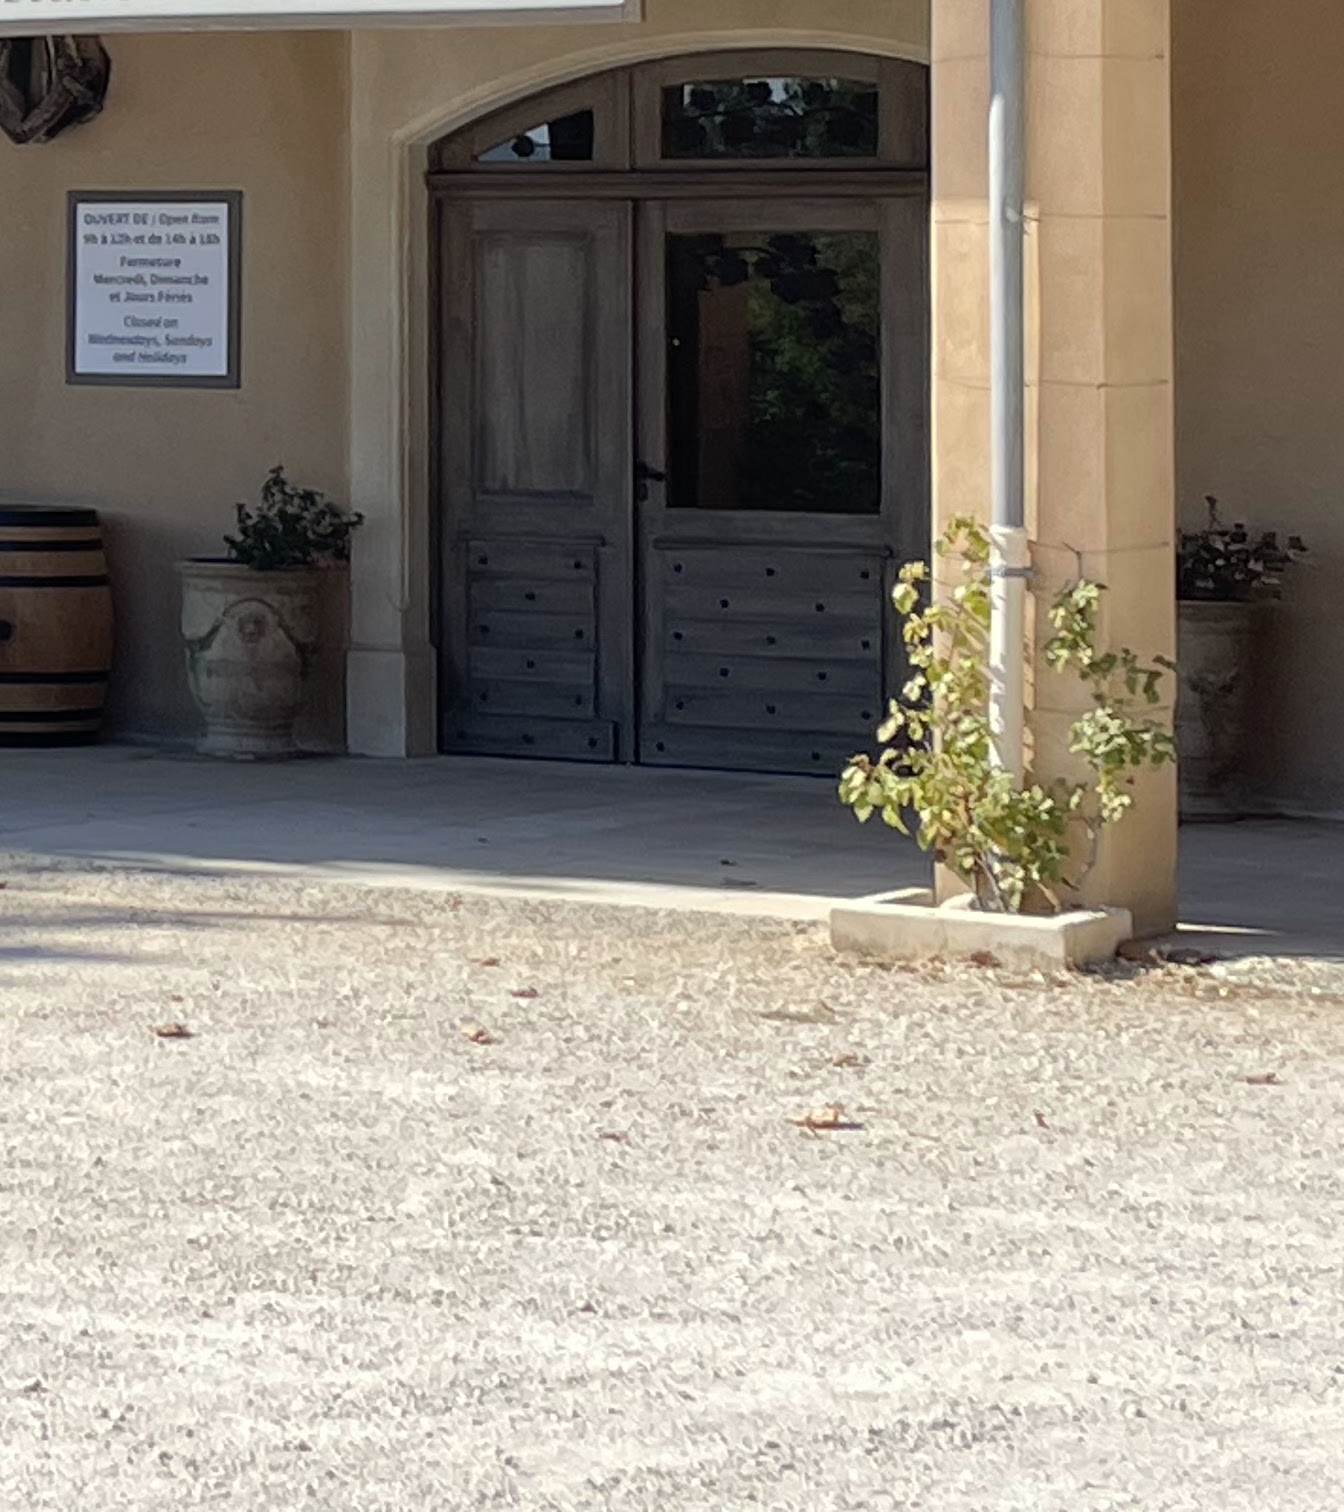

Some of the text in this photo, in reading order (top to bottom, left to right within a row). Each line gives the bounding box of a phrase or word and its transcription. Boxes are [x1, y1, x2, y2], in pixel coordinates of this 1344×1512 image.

[83, 213, 130, 225] OUVERT
[133, 213, 149, 225] DE
[159, 214, 189, 227] Open
[120, 256, 182, 267] Fermeture
[150, 274, 209, 285] Dimanche
[123, 292, 155, 303] Jours
[123, 315, 179, 328] Closed on
[165, 334, 213, 348] Sundays
[113, 351, 135, 363] and
